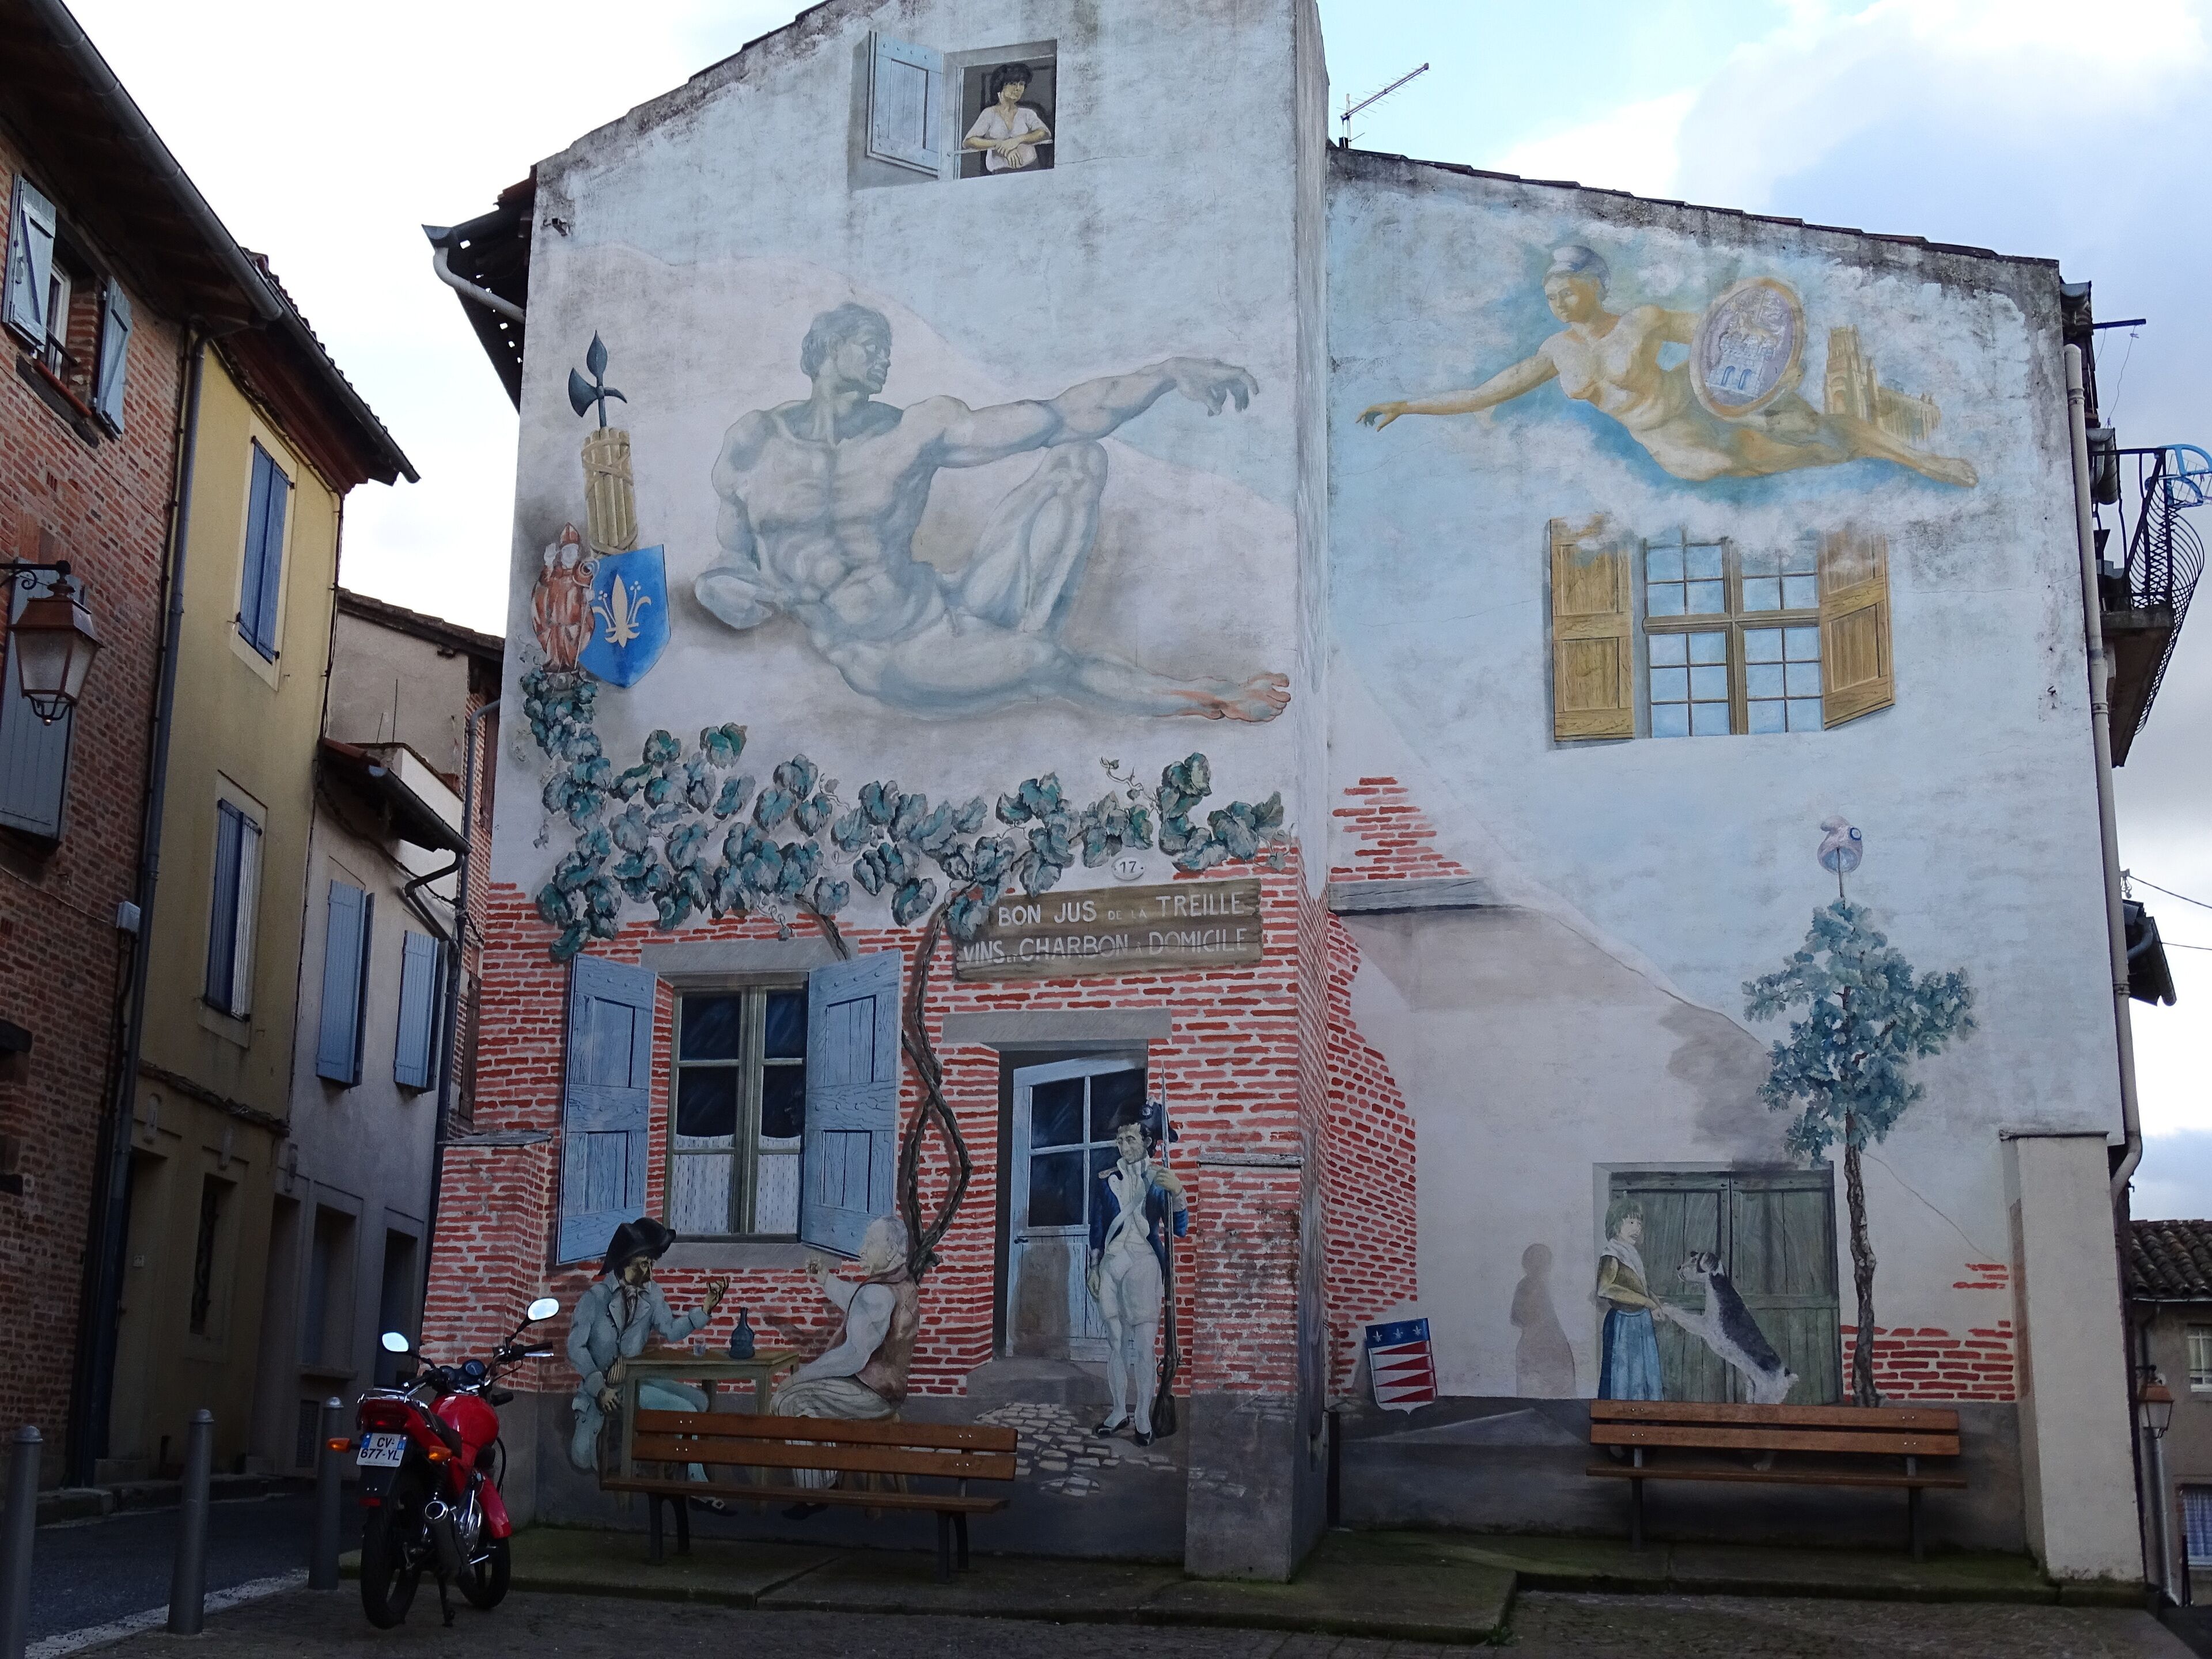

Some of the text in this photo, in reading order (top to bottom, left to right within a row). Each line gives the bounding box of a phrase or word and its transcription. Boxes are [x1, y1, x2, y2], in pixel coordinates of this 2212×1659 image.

[1119, 861, 1137, 873] 17
[998, 892, 1245, 926] BON JUS DE LA TREILLE
[963, 940, 1005, 965] VINS
[1019, 934, 1128, 962] CHARBON
[1149, 928, 1247, 955] DOMICILE
[361, 1448, 399, 1461] 677-YL
